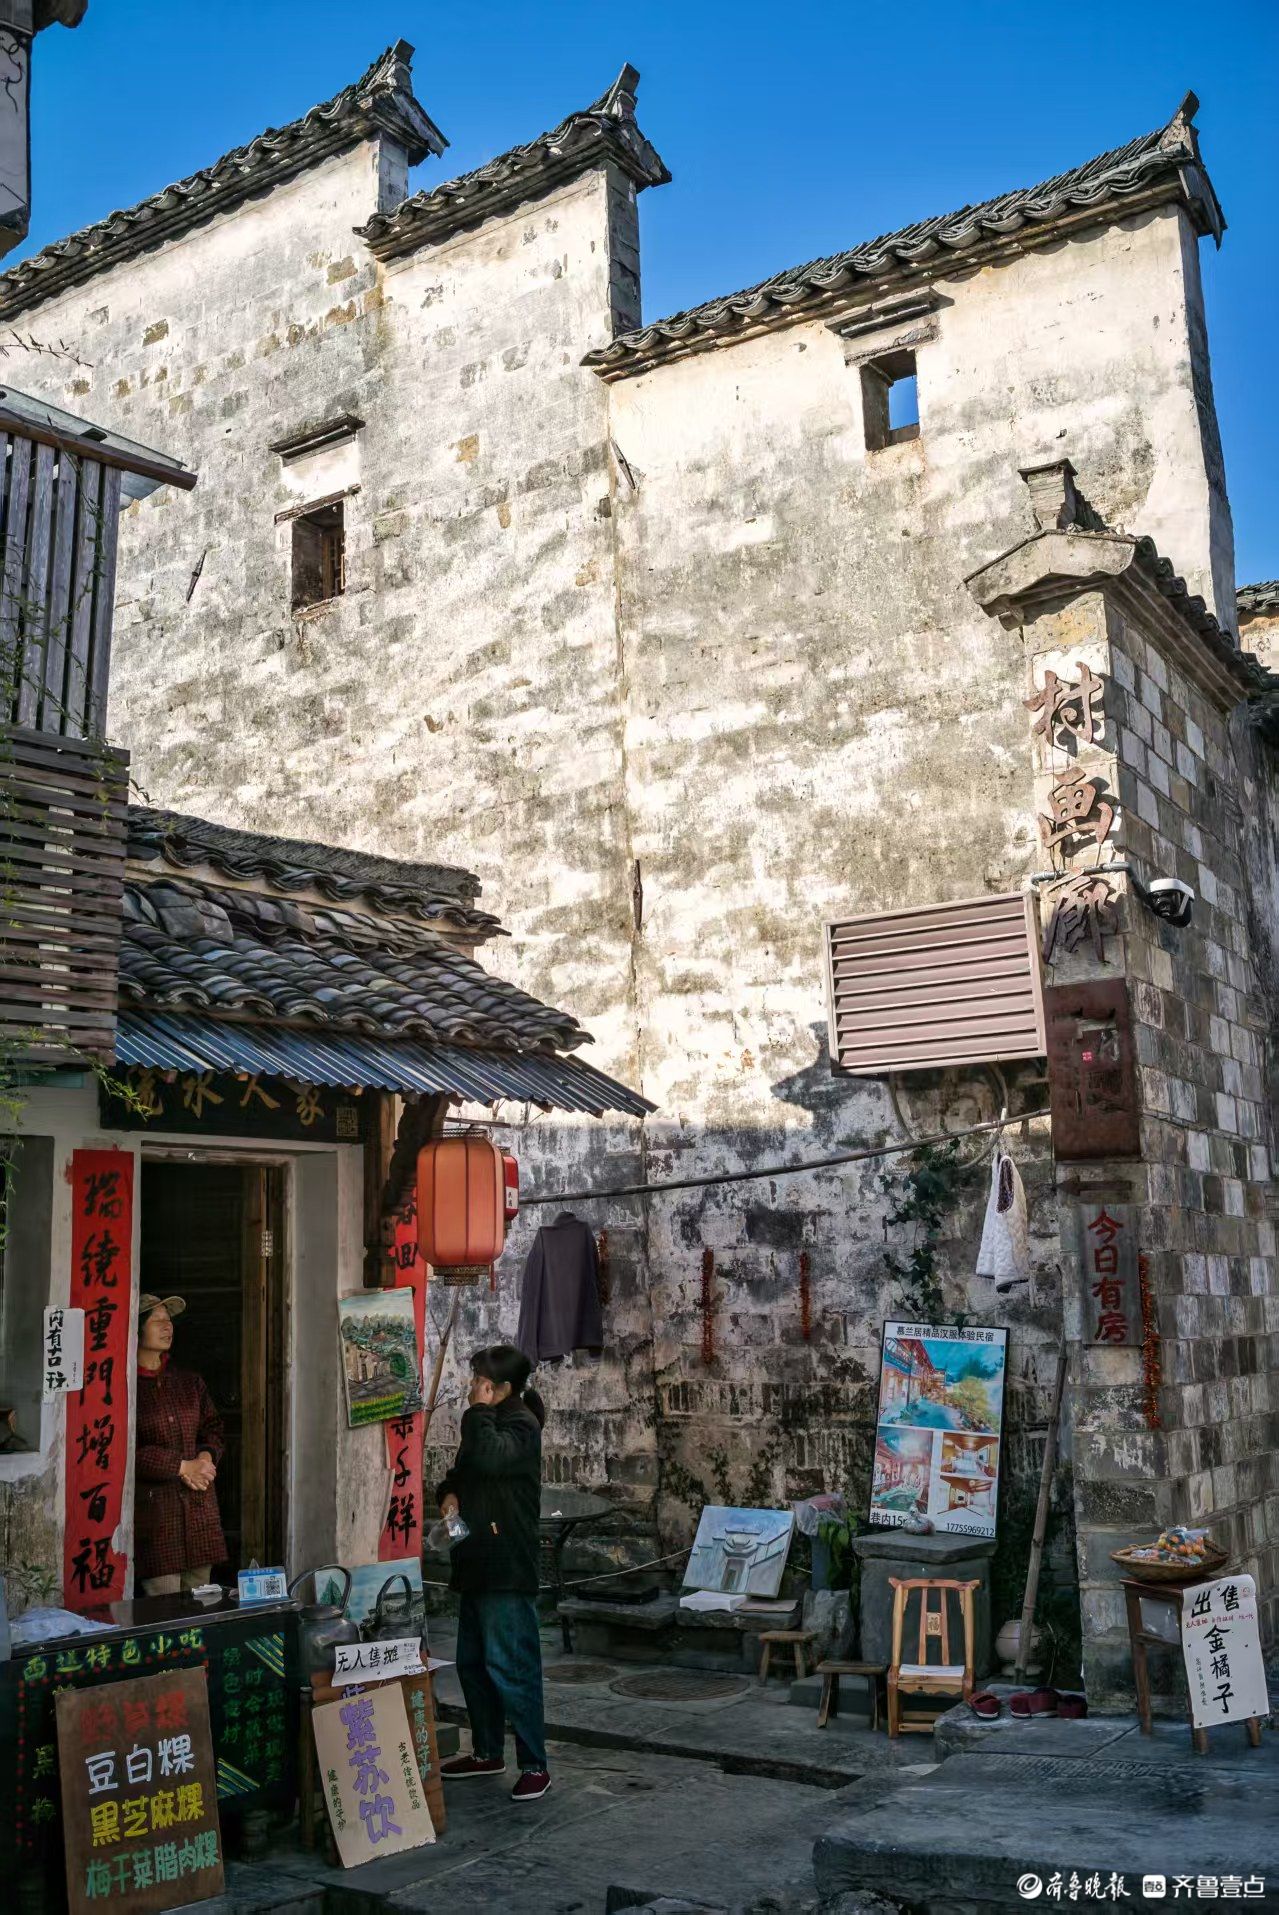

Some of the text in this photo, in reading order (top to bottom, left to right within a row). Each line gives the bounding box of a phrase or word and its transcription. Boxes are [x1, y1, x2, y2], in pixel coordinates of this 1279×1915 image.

[1087, 1208, 1130, 1343] 今日有房
[946, 1522, 995, 1537] 17755969212
[1191, 1584, 1240, 1619] 出售
[336, 1645, 400, 1673] 无人售摊
[1203, 1623, 1235, 1714] 金橘子
[85, 1733, 195, 1796] 豆白粿
[339, 1697, 403, 1845] 紫苏饮
[86, 1829, 220, 1899] 梅干菜腊肉粿
